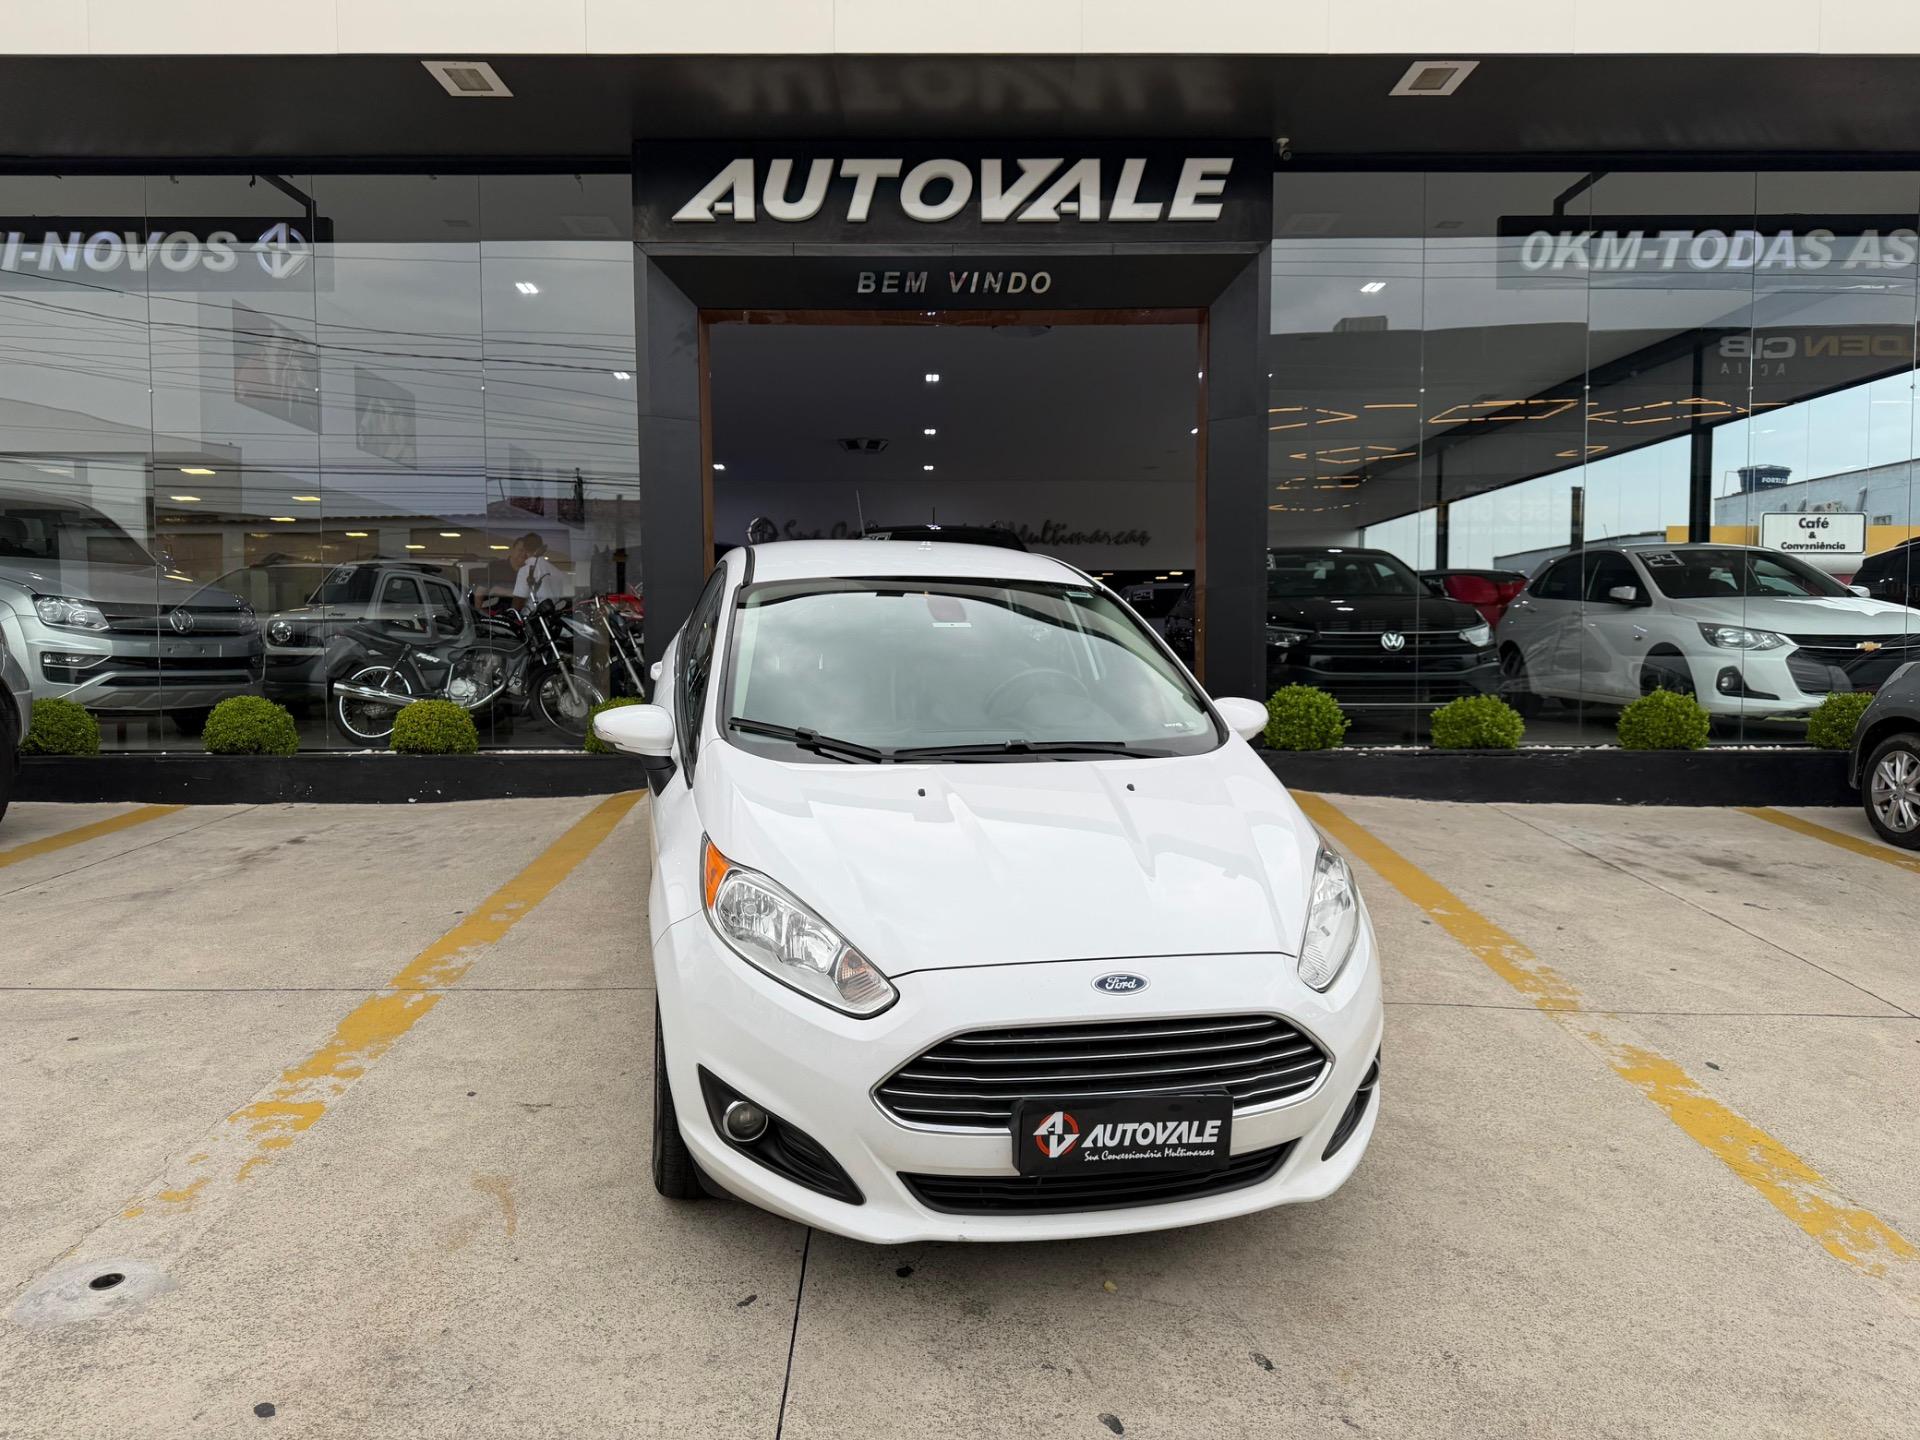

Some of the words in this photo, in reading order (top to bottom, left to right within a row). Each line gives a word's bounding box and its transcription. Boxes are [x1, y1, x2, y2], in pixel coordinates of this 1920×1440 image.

[672, 157, 1234, 223] AUTOVALE
[0, 231, 238, 273] I-NOVOS
[1840, 228, 1919, 270] AS
[857, 271, 928, 294] BEM
[949, 271, 1052, 294] VINDO
[1798, 517, 1829, 529] Café
[1808, 531, 1817, 539] &
[1105, 975, 1137, 990] Ford
[1080, 1120, 1222, 1148] AUTOVALE
[1083, 1151, 1099, 1161] Sua
[1164, 1146, 1215, 1158] Multimarcas
